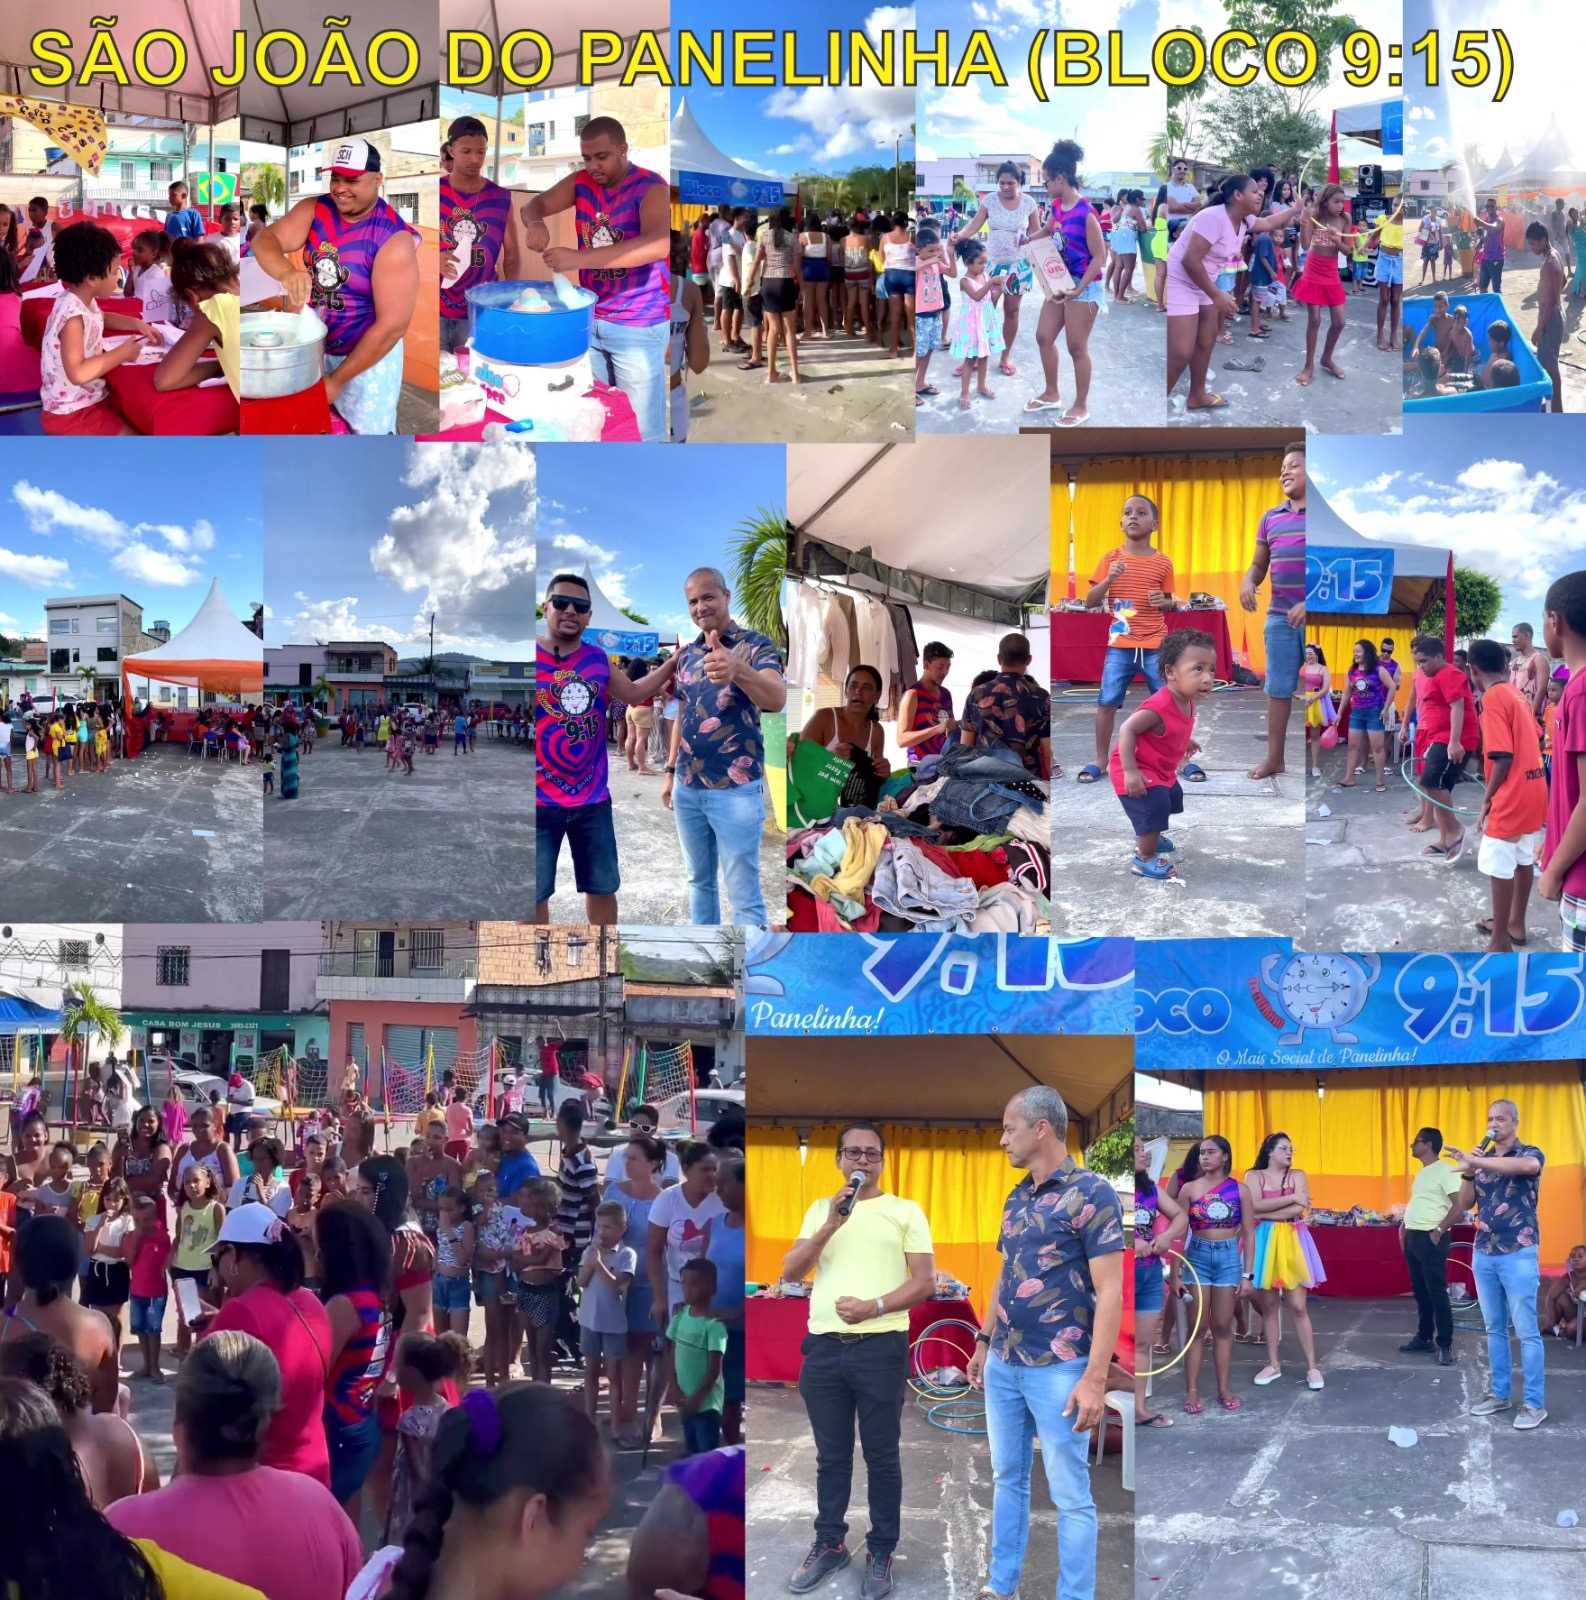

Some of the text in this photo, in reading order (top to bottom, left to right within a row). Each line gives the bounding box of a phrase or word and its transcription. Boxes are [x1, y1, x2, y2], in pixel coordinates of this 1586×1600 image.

[1394, 952, 1585, 1044] 9:15
[142, 1019, 165, 1027] CASA
[168, 1020, 189, 1028] BOM
[191, 1021, 221, 1030] JESUS
[751, 1000, 885, 1030] Panelinha!
[1216, 1045, 1418, 1066] O Mais Social de Panelinha!
